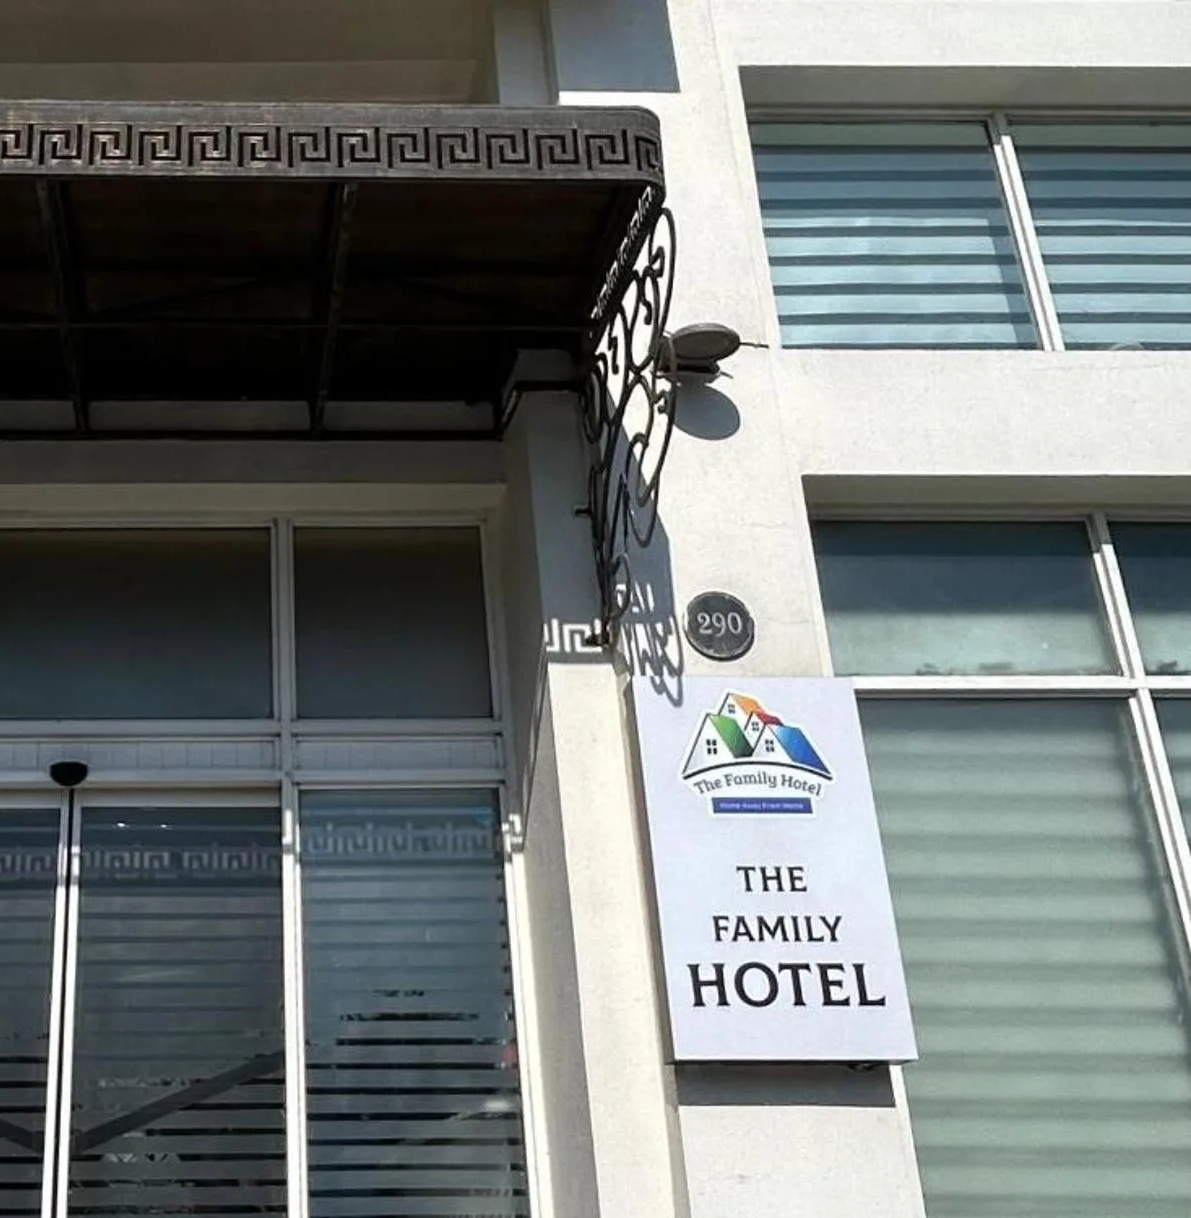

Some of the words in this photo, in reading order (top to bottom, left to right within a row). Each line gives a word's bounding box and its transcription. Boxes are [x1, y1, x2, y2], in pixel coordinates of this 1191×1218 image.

[696, 611, 743, 637] 290
[693, 777, 723, 794] The
[723, 771, 778, 788] Family
[781, 774, 822, 796] Hotel
[736, 865, 808, 892] THE
[712, 915, 842, 942] FAMILY
[686, 961, 886, 1008] HOTEL
